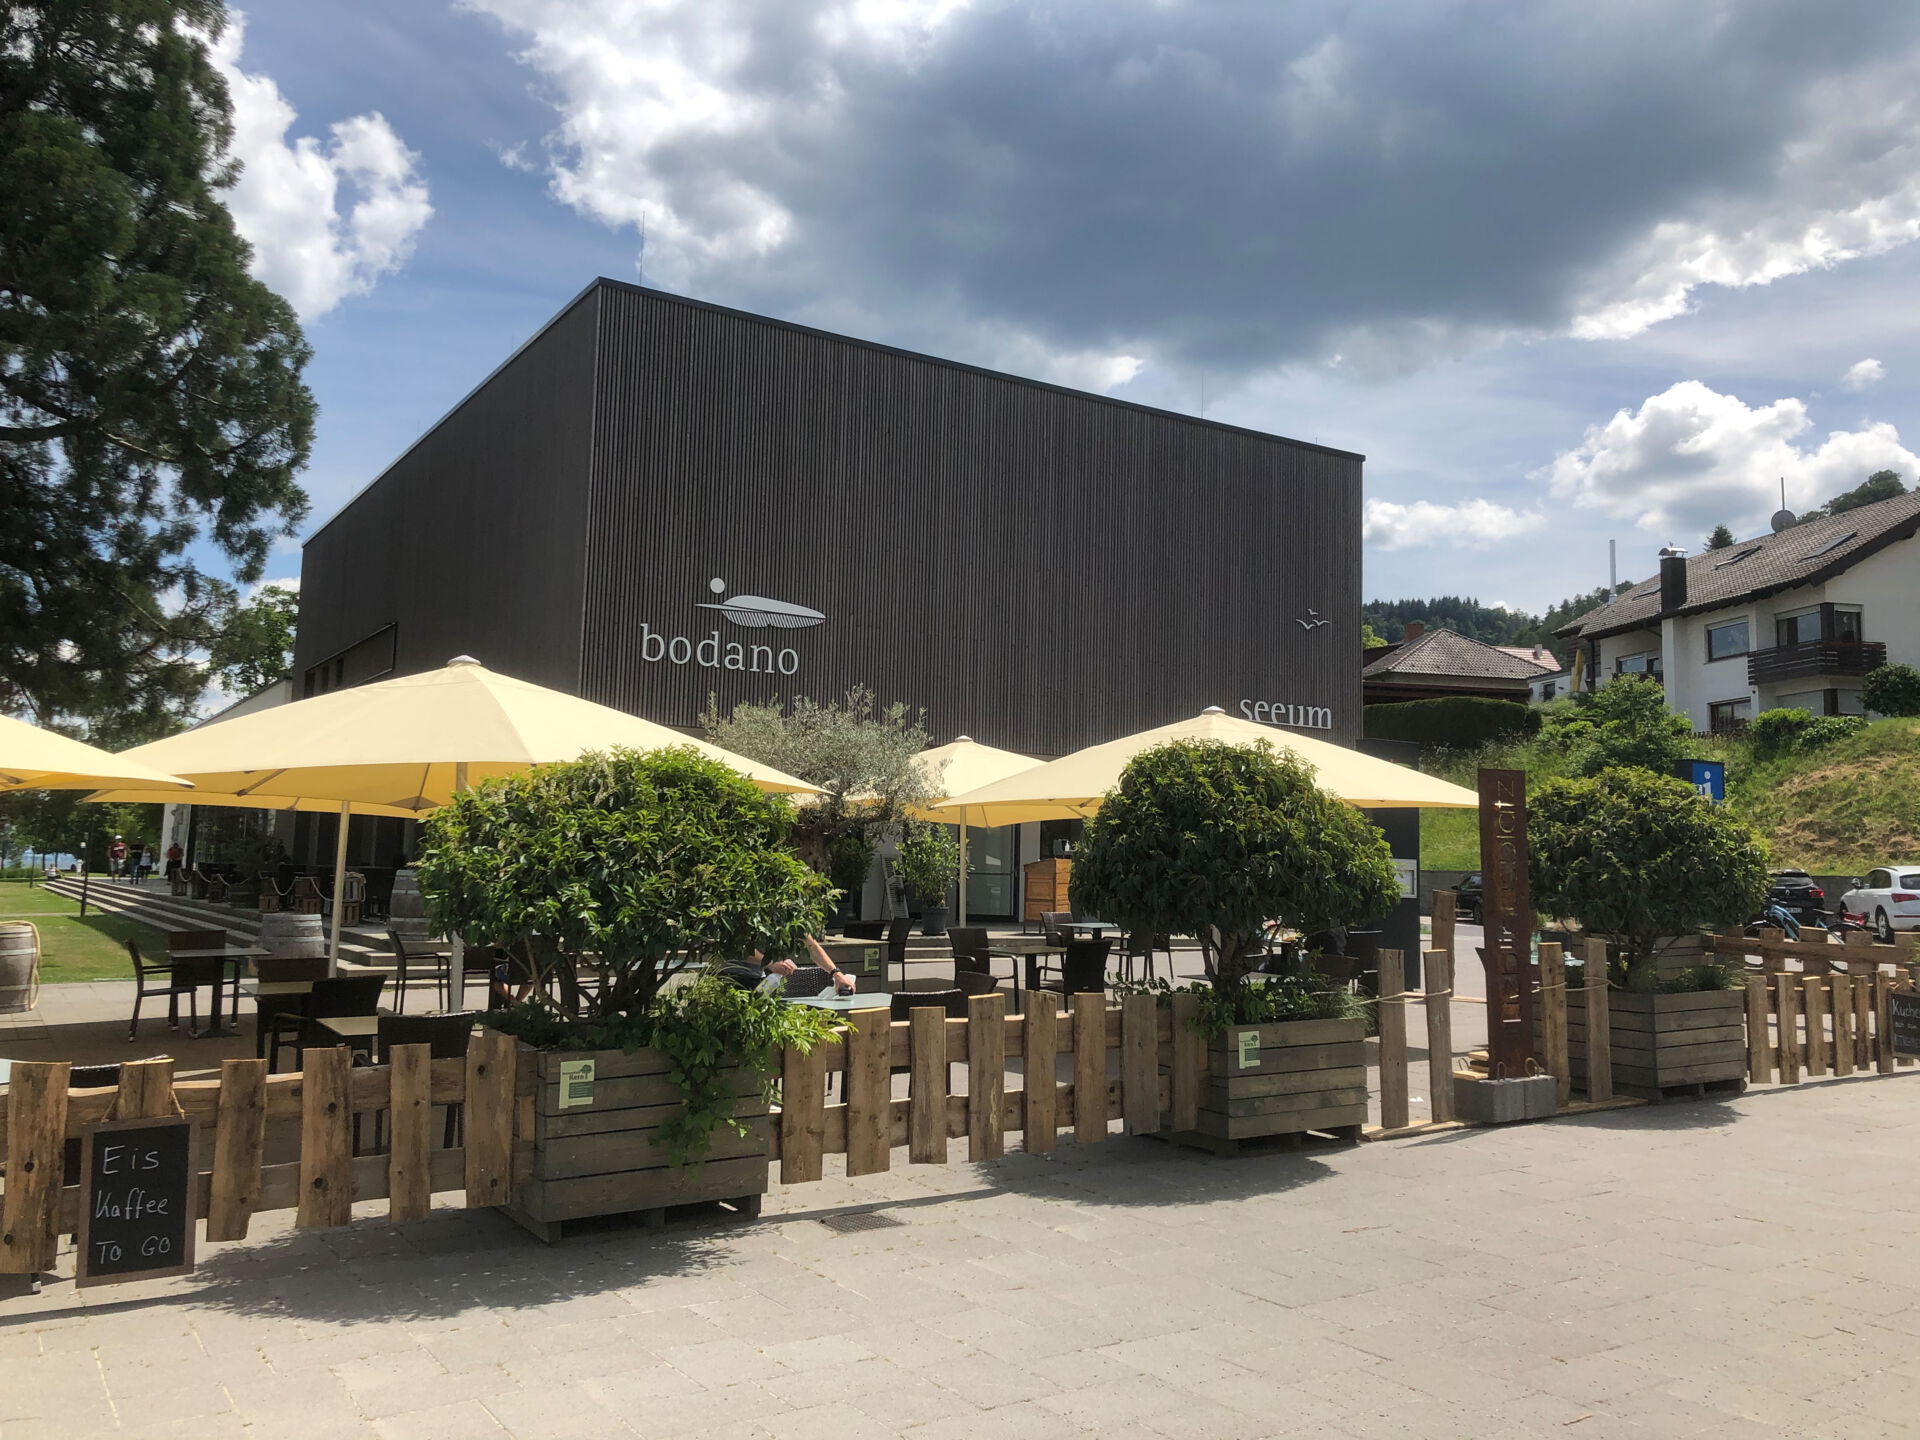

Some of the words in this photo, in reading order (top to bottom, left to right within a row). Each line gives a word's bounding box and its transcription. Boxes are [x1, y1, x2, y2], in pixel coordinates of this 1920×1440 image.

[640, 623, 799, 675] bodano
[1240, 699, 1332, 729] seeum
[103, 1145, 160, 1174] Eis
[95, 1187, 169, 1220] Kaffee
